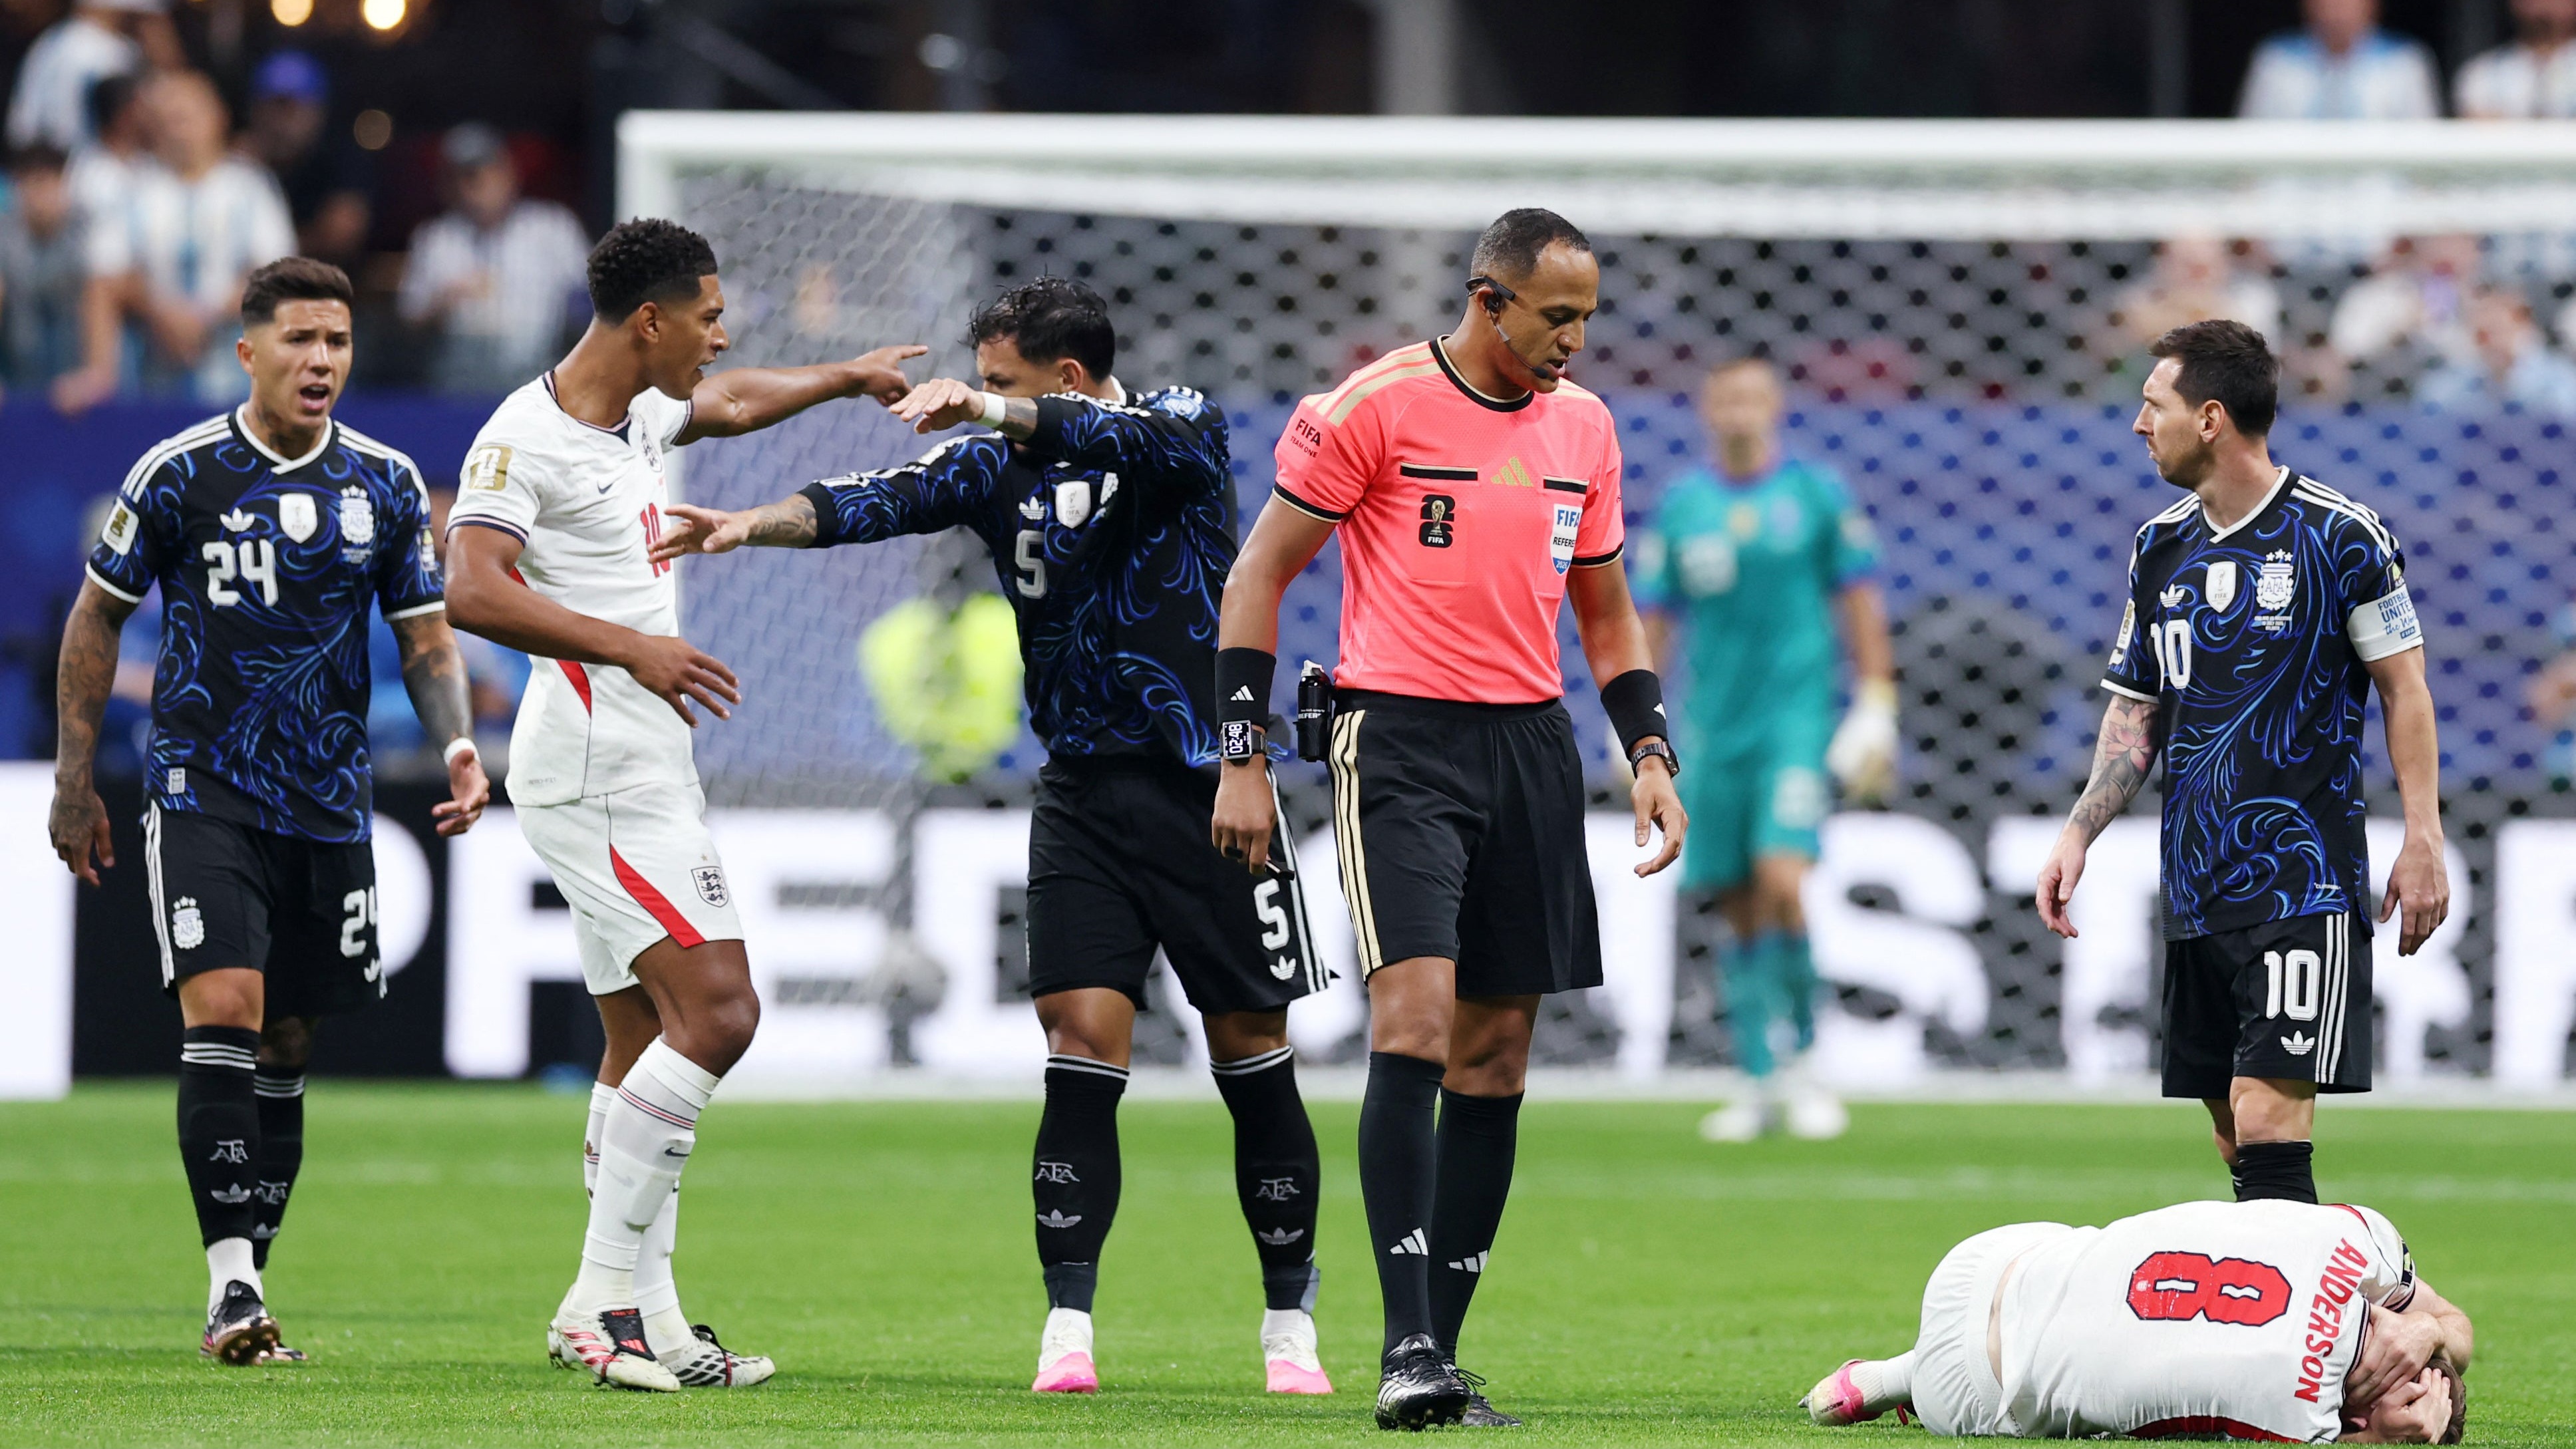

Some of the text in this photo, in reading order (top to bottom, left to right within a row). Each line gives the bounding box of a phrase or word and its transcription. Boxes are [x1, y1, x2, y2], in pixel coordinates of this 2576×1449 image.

[1291, 436, 1318, 458] TEAM ONE
[1295, 418, 1321, 446] FIFA
[202, 539, 279, 606] 24
[641, 502, 670, 577] 10
[1015, 530, 1047, 599] 5
[1553, 536, 1575, 548] REFERE
[2150, 619, 2191, 692] 10
[2383, 623, 2400, 635] the
[1228, 724, 1243, 753] 02:48
[1253, 878, 1290, 951] 5
[2264, 950, 2321, 1021] 10
[1035, 1162, 1080, 1184] AFA
[1256, 1177, 1299, 1201] AFA
[2126, 1251, 2293, 1327] 8
[2293, 1237, 2368, 1404] ANDERSON
